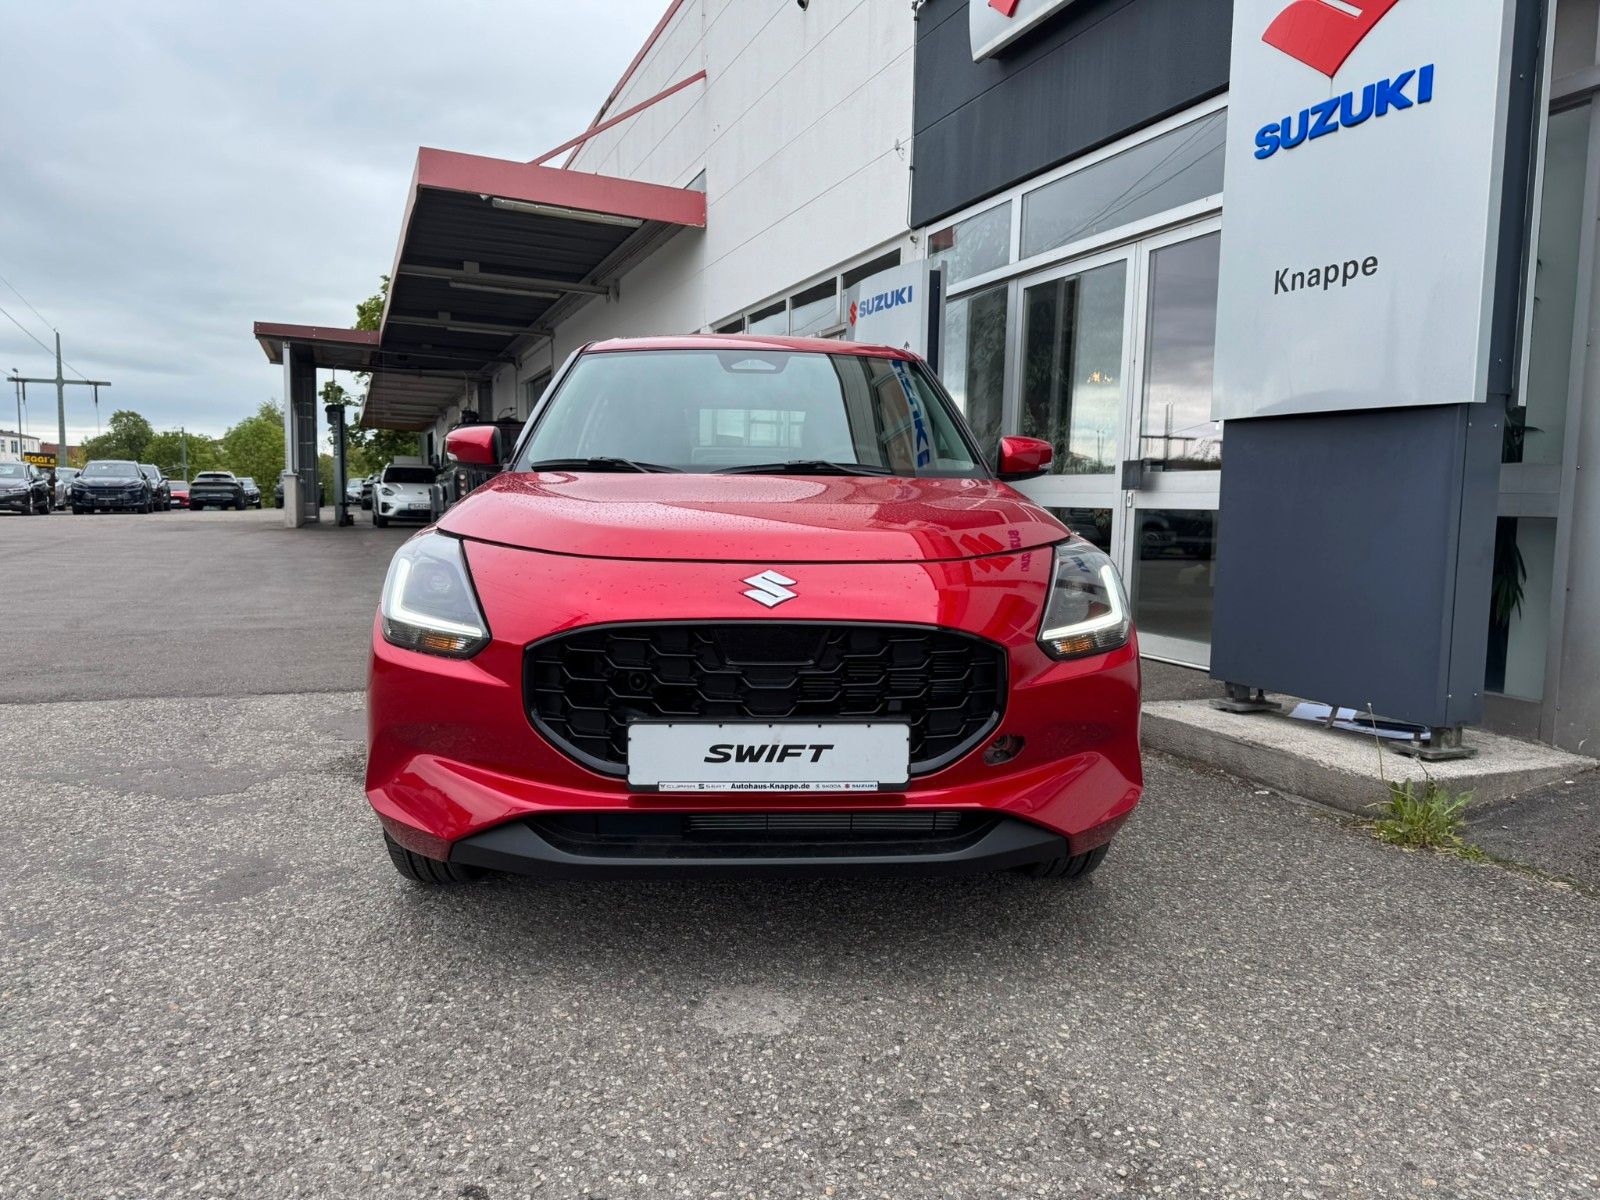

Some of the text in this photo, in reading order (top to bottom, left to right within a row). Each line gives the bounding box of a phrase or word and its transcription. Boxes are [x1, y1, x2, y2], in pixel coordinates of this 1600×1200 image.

[1253, 63, 1435, 160] SUZUKI
[1273, 255, 1379, 295] Knappe
[858, 285, 913, 318] SUZUKI
[703, 743, 835, 763] SWIFT
